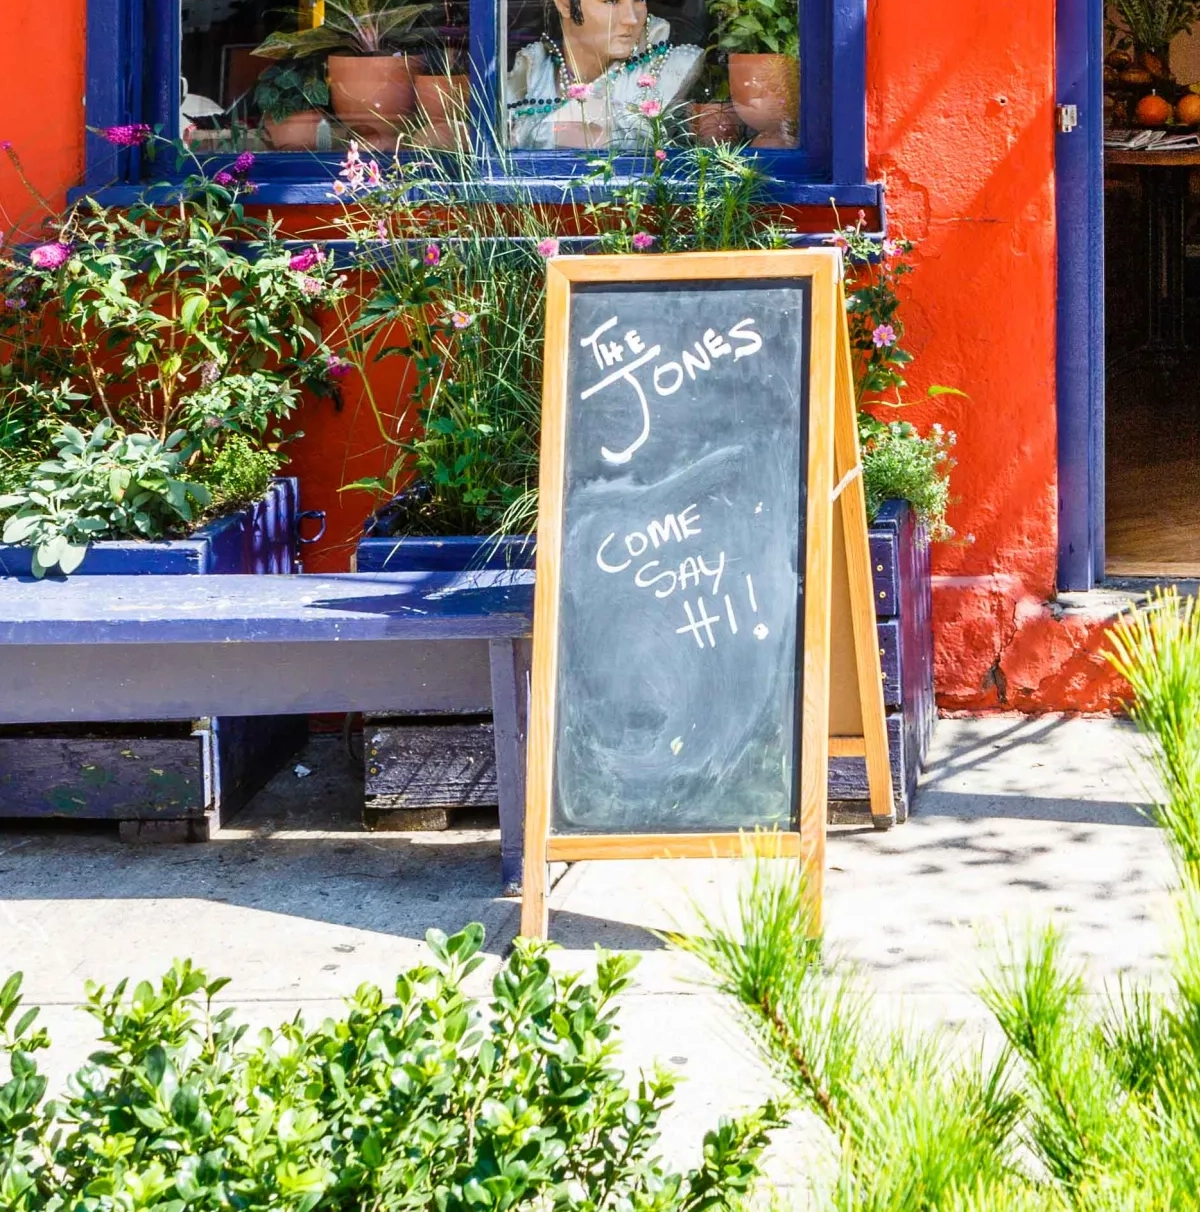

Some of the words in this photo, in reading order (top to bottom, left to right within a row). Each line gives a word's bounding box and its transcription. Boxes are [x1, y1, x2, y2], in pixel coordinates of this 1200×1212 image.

[580, 315, 646, 370] THE
[580, 318, 763, 466] JONES
[596, 503, 702, 574] COME
[634, 551, 725, 599] SAY
[675, 573, 770, 649] HI!
